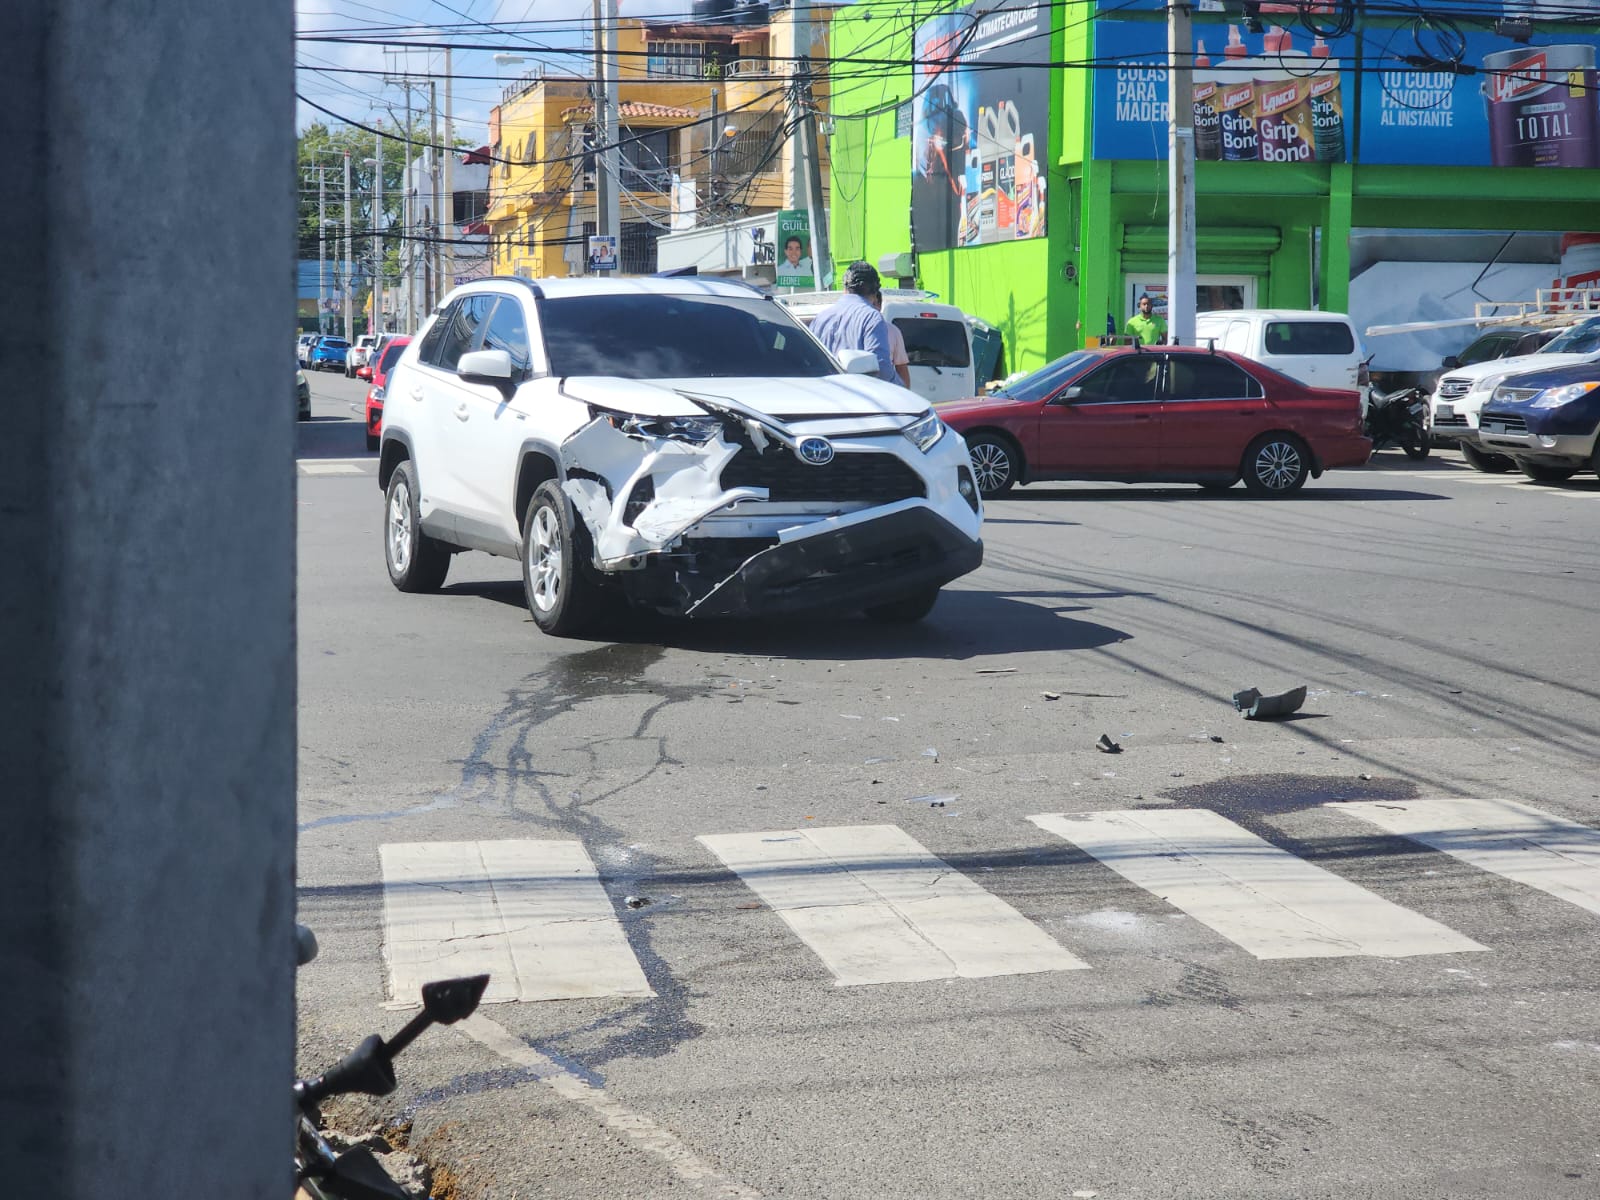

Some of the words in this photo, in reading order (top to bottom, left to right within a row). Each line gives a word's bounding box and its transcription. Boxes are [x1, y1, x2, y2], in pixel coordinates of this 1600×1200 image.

[1116, 61, 1168, 82] COLAS
[1404, 69, 1454, 89] COLOR
[1116, 81, 1158, 102] PARA
[1262, 88, 1296, 112] LANCO
[1381, 88, 1454, 110] FAVORITO
[1116, 101, 1169, 122] MADER
[1193, 103, 1215, 116] Grip
[1311, 99, 1333, 115] Grip
[1194, 112, 1220, 127] Bond
[1222, 113, 1253, 134] Grip
[1312, 111, 1340, 127] Bond
[1381, 109, 1397, 126] AL
[1397, 110, 1454, 128] INSTANTE
[1516, 113, 1572, 140] TOTAL
[1260, 119, 1299, 143] Grip
[1262, 138, 1310, 162] Bond
